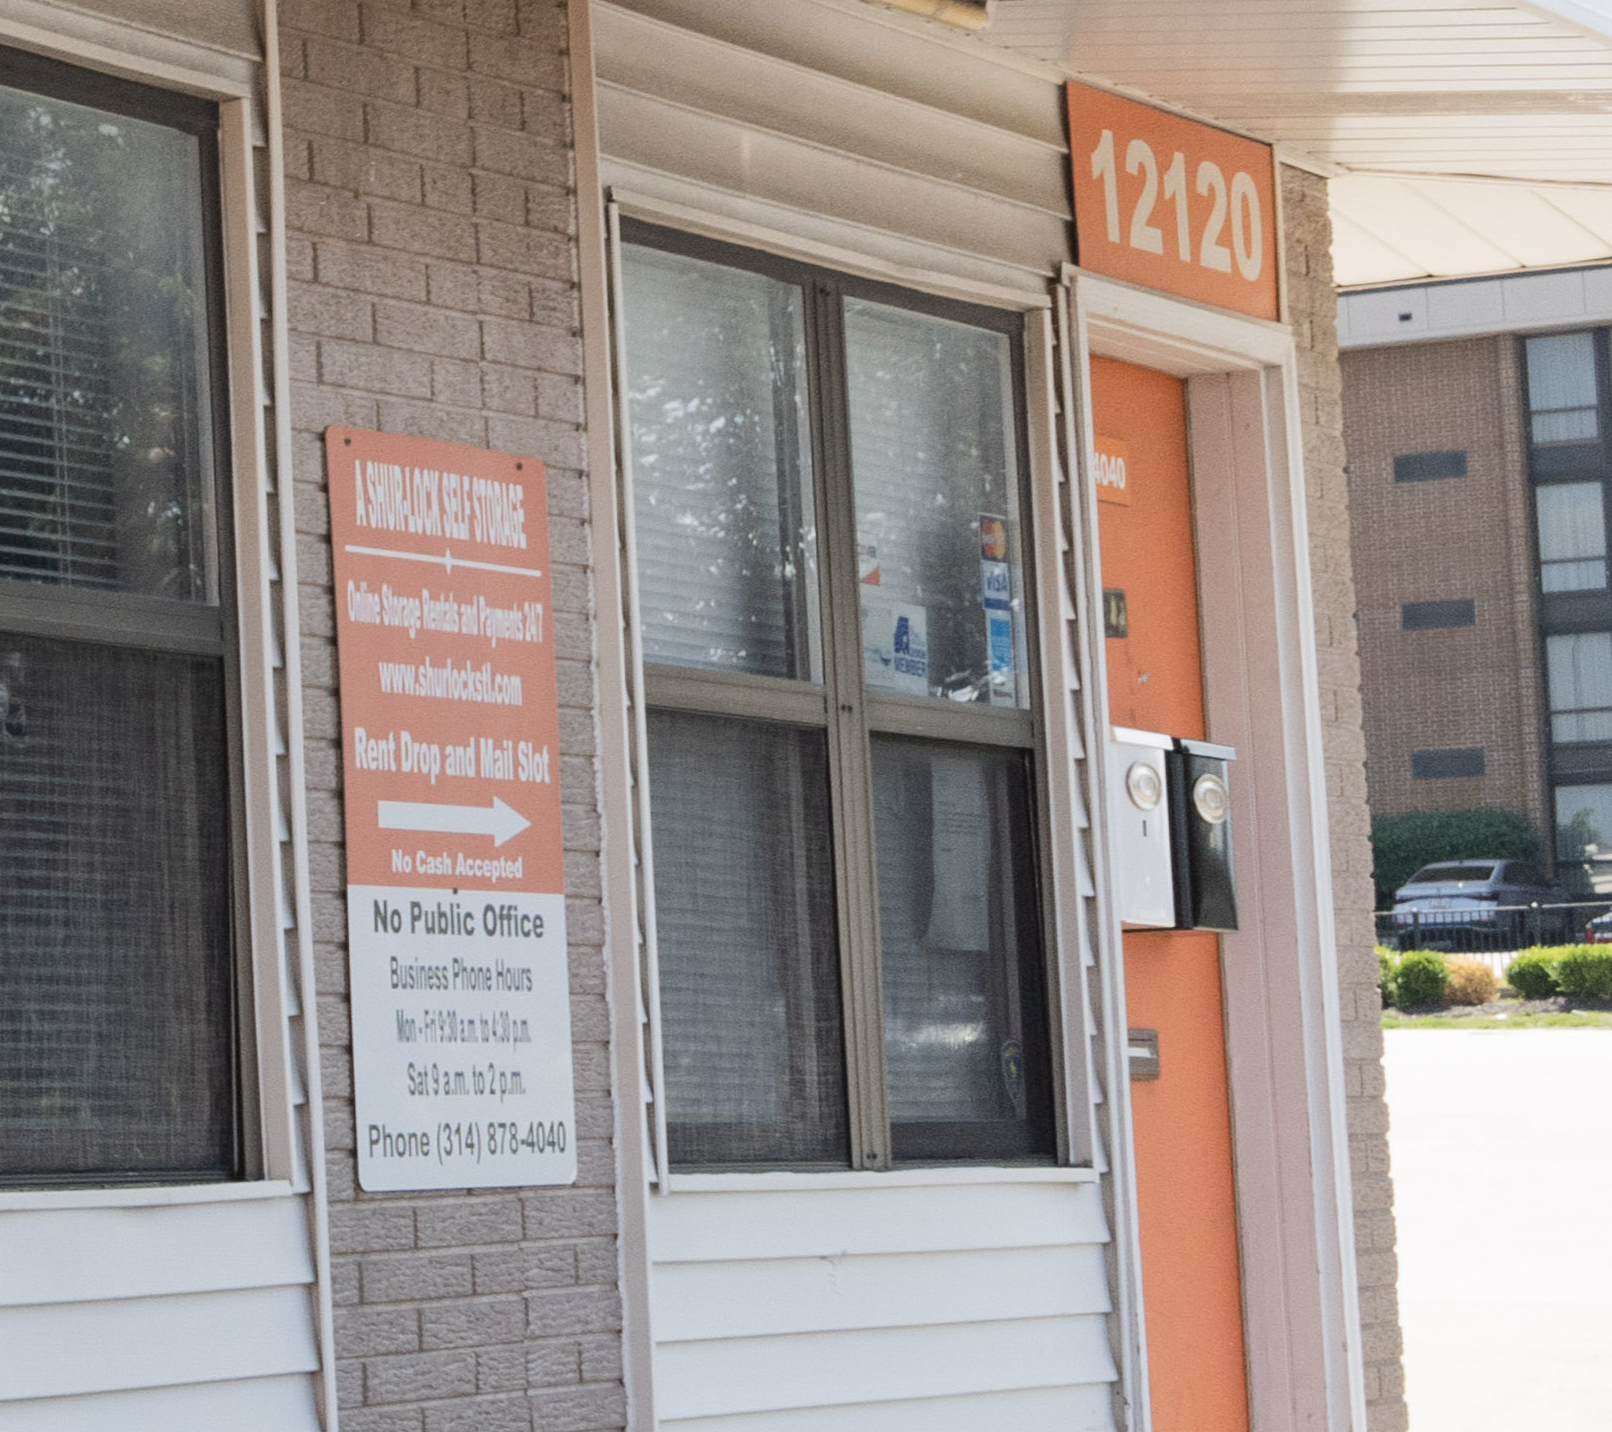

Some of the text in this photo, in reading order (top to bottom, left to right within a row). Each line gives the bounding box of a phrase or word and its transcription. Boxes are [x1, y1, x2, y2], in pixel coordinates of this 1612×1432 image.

[1091, 129, 1262, 281] 12120
[355, 459, 527, 549] A SHUR-LOCK SELF STORAGE
[987, 573, 1008, 592] VISA
[347, 579, 380, 625] Online
[382, 583, 421, 639] Storage
[422, 588, 459, 633] Rentals
[461, 594, 478, 635] and
[479, 595, 523, 648] Payments
[379, 655, 523, 705] www.shurlockstl.com
[354, 726, 550, 785] Rent Drop and Mail Slot
[391, 849, 523, 883] No Cash Accepted
[373, 899, 544, 938] No Public Office
[390, 956, 533, 992] Business Phone Hours
[396, 1009, 416, 1043] Mon
[424, 1010, 437, 1043] Fri
[438, 1010, 457, 1043] 9:30
[460, 1018, 479, 1043] a.m.
[480, 1014, 490, 1043] to
[492, 1010, 510, 1043] 4:30
[513, 1018, 532, 1052] p.m.
[407, 1062, 526, 1104] Sat 9 a.m. to 2 p.m.
[368, 1120, 566, 1166] Phone (314) 878-4040
